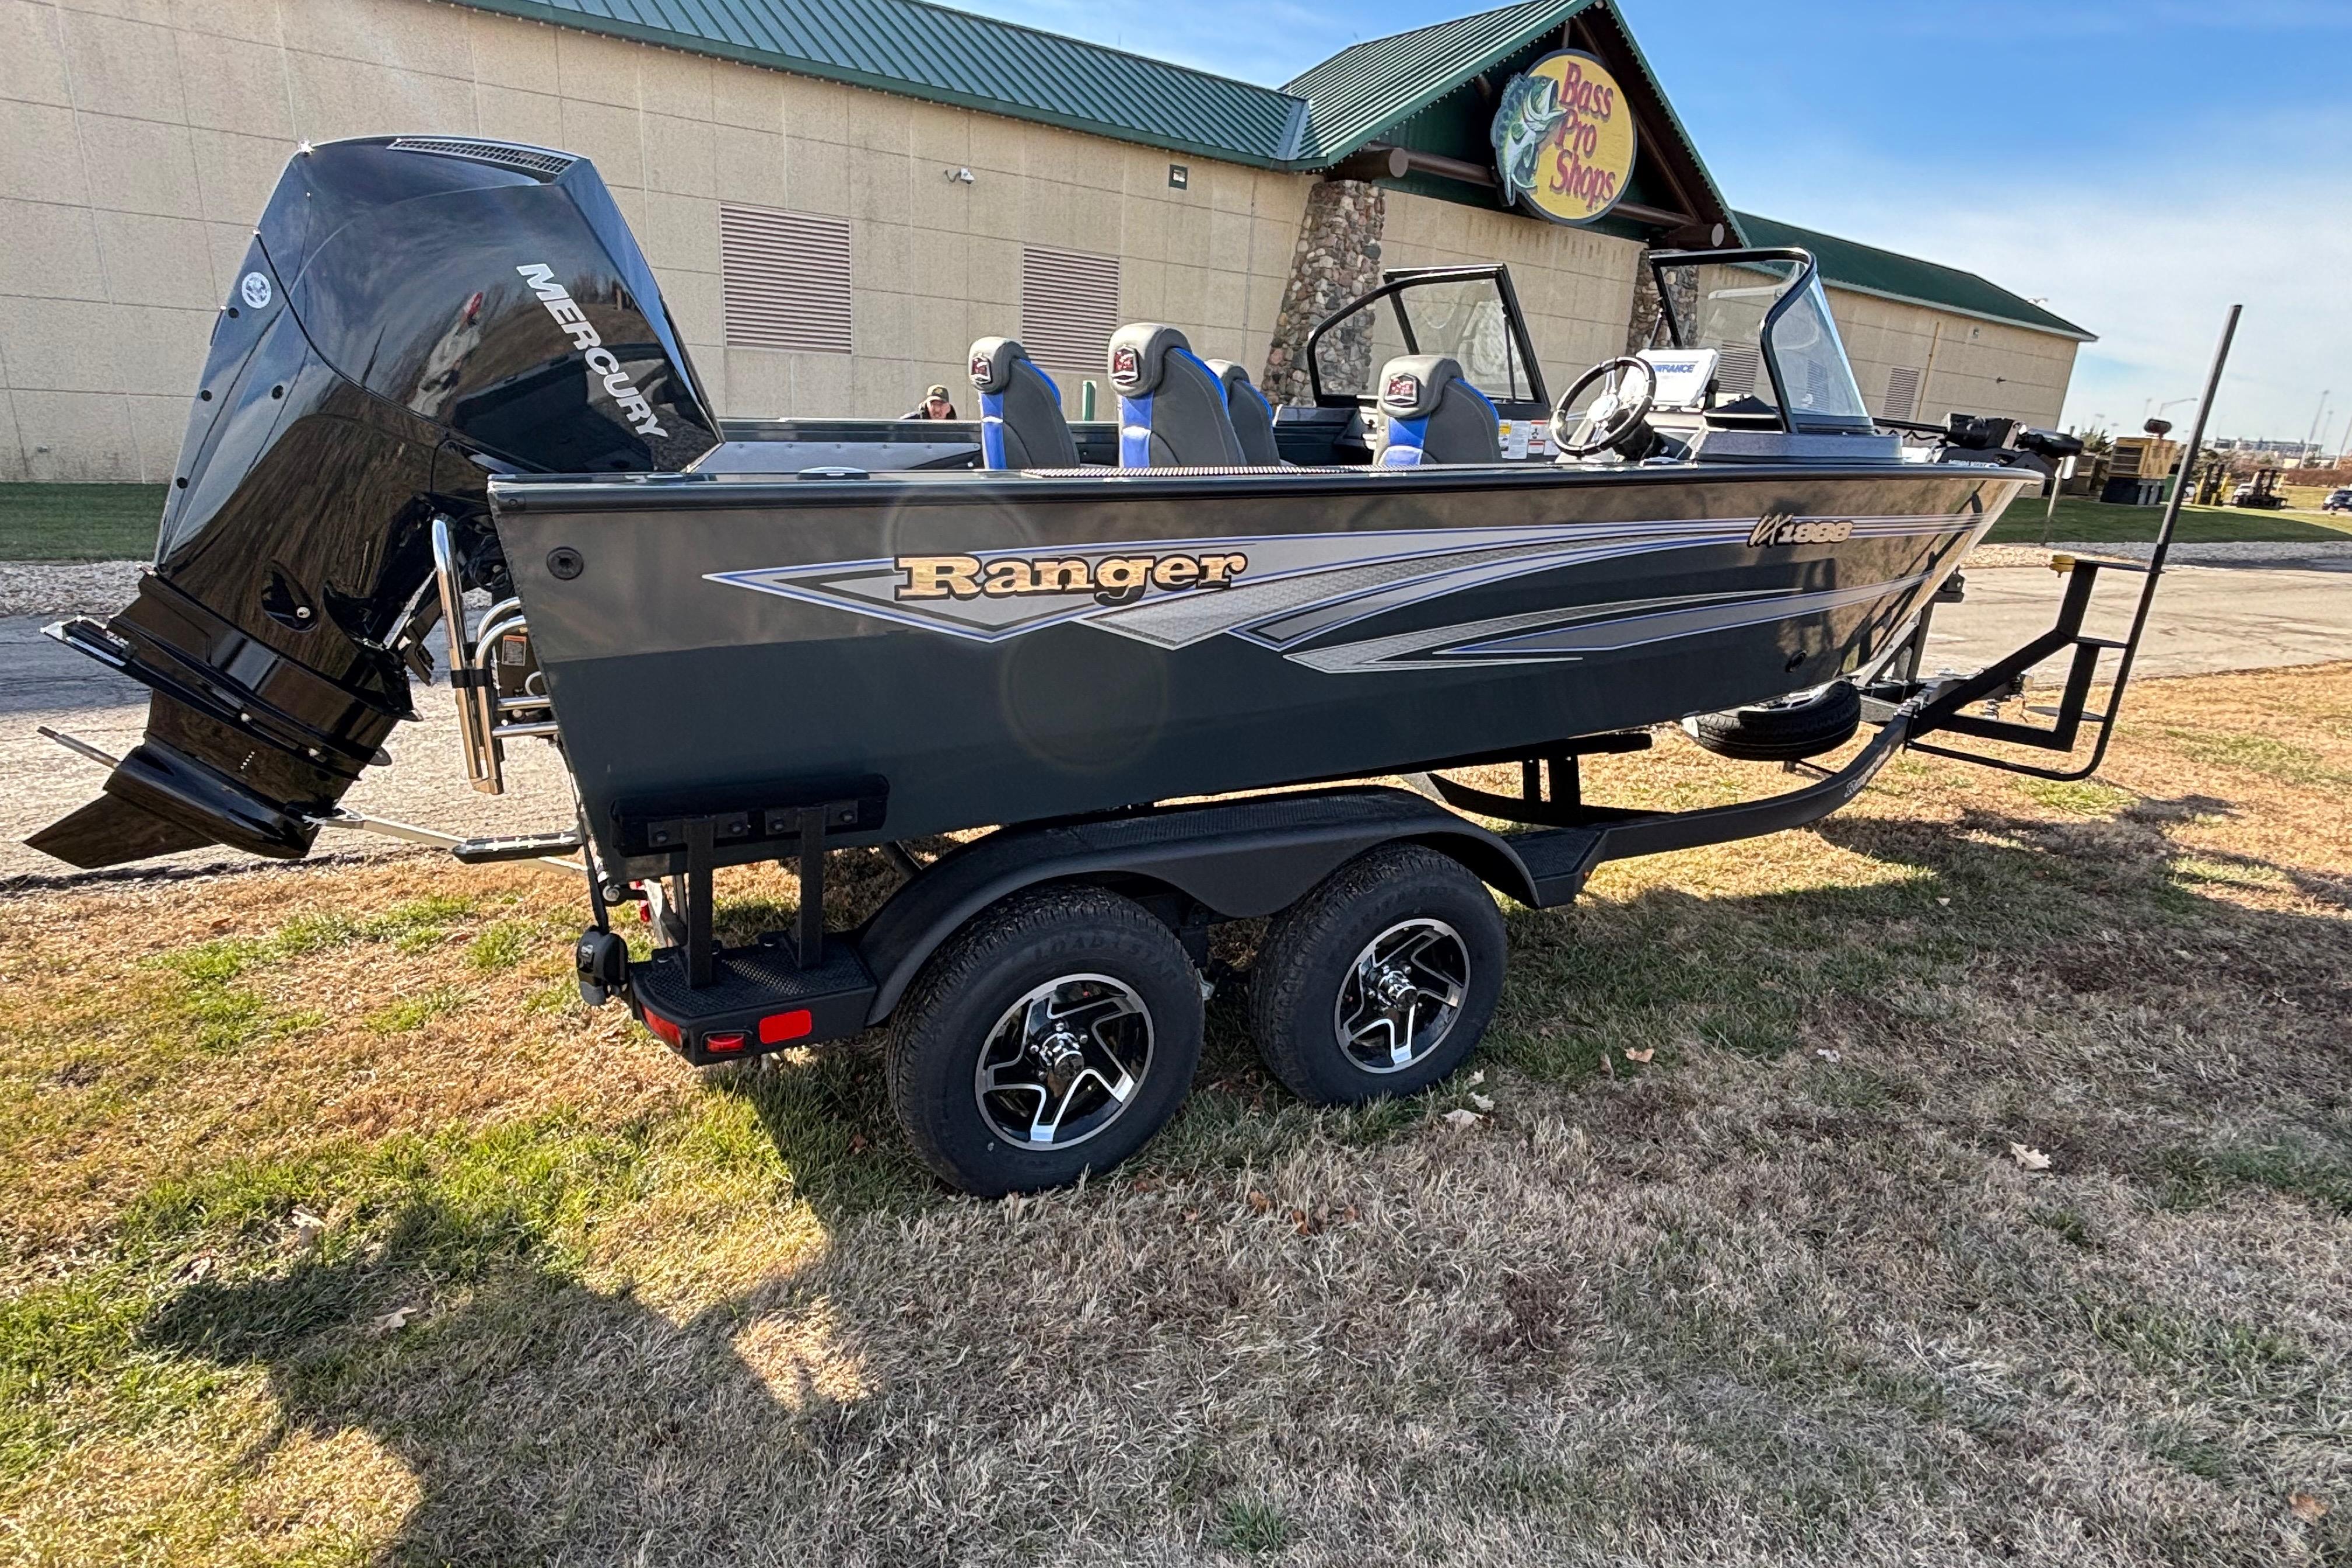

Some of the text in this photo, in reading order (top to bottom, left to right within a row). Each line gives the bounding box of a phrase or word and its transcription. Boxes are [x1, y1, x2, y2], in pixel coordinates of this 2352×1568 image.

[1559, 61, 1614, 120] Bass
[1555, 108, 1597, 156] Pro
[1549, 149, 1616, 211] Shops
[516, 263, 668, 438] MERCURY
[1651, 364, 1696, 373] WRANCE
[896, 553, 1247, 604] Ranger
